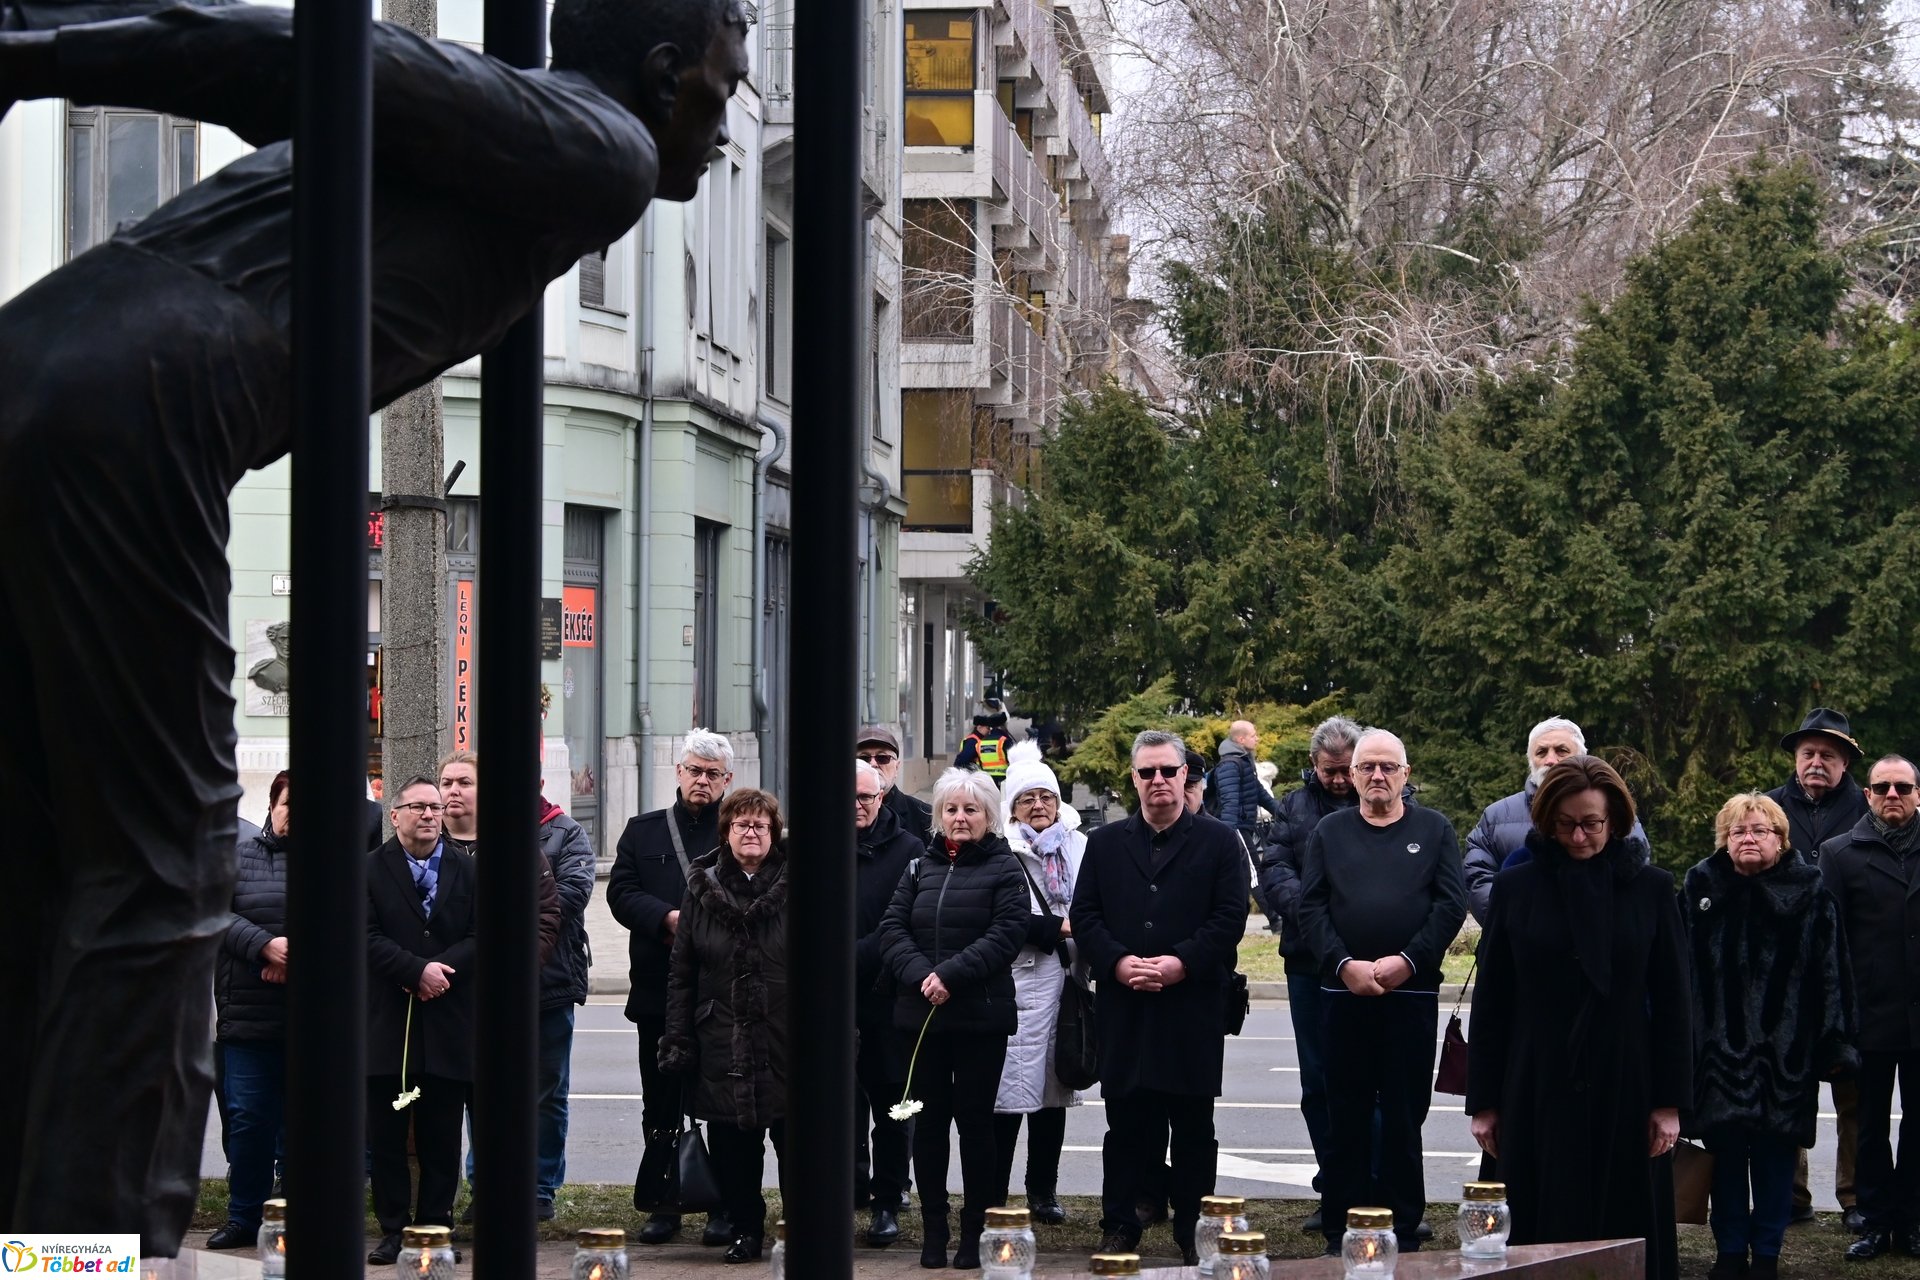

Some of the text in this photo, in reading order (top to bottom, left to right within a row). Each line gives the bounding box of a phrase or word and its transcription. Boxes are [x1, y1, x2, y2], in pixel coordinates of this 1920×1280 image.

[457, 590, 468, 751] LEONI PÉKS
[564, 606, 593, 642] ÉKSÉG
